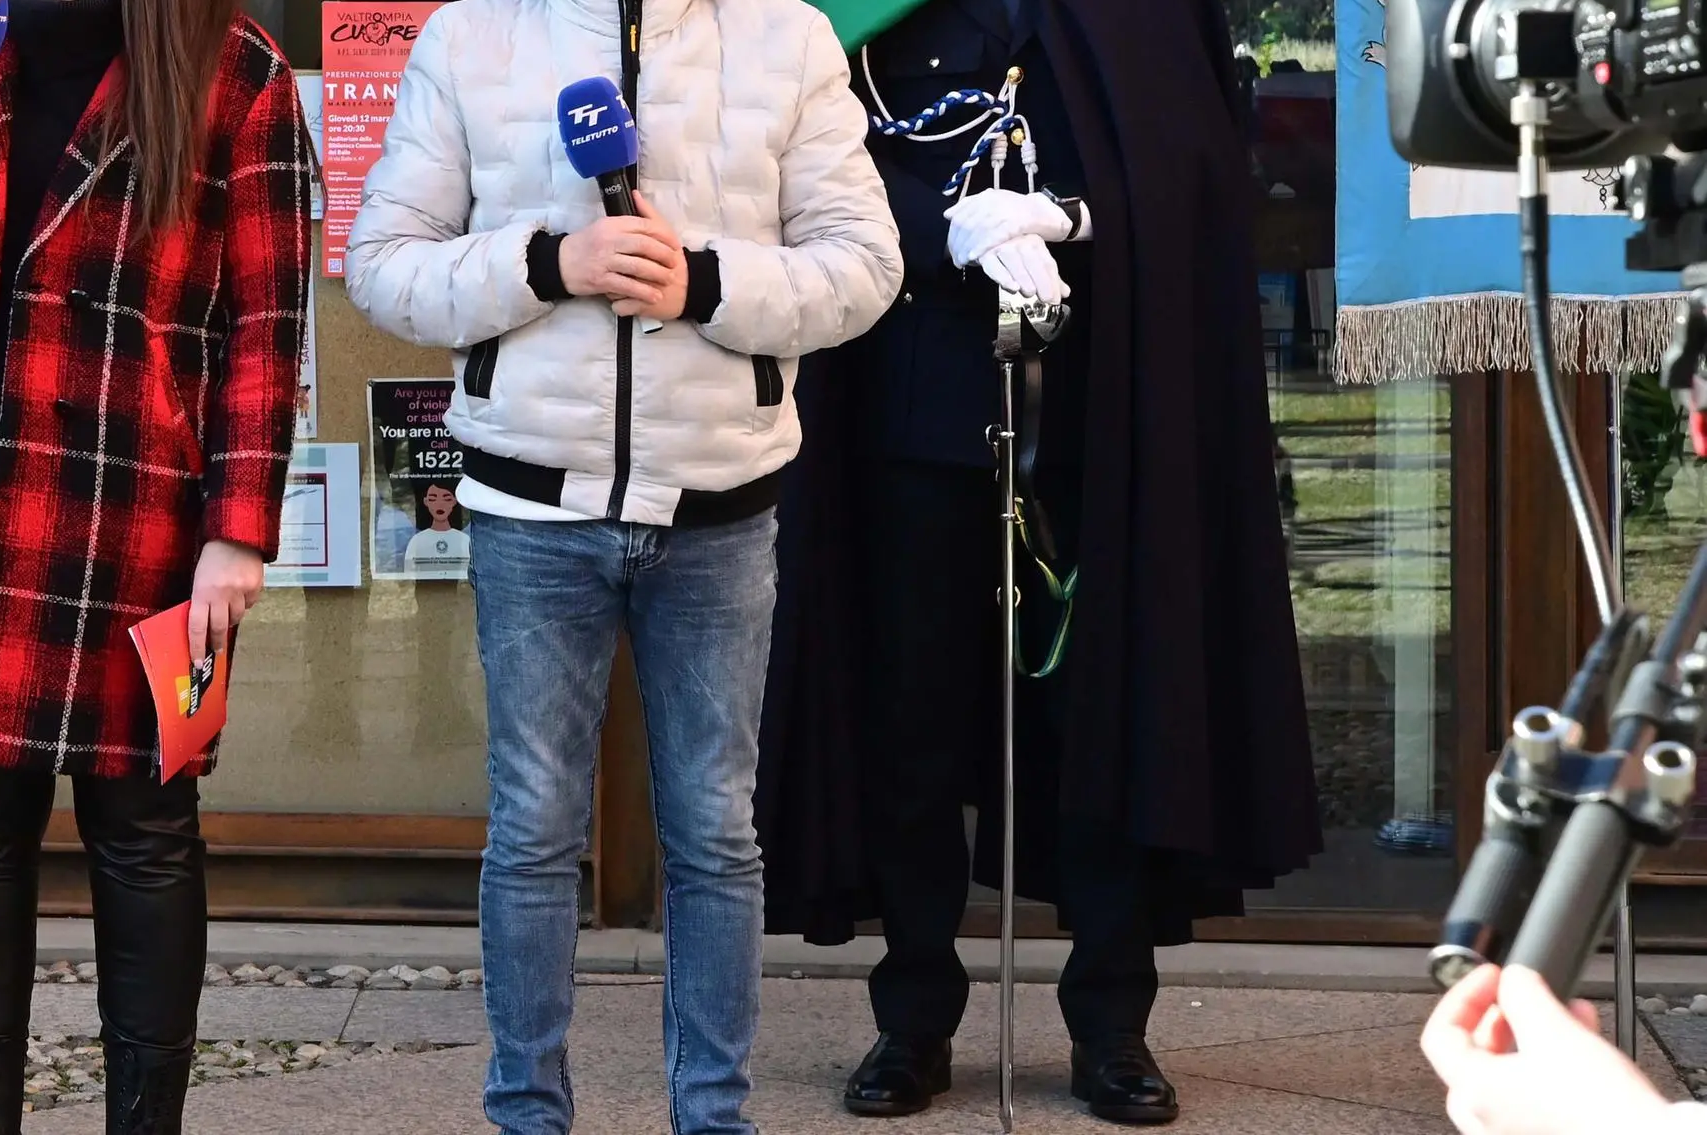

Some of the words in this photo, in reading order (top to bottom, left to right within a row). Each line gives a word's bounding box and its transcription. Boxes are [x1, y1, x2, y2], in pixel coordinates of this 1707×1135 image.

[337, 12, 413, 23] VALTROMPIA
[325, 71, 390, 79] PRESENTAZIONE
[325, 83, 398, 100] TRAN
[359, 114, 370, 122] 12
[342, 124, 366, 133] 20:30
[571, 125, 619, 147] TELETUTTO
[394, 388, 414, 398] Are
[416, 389, 437, 399] you
[440, 390, 447, 398] a
[408, 401, 420, 410] of
[406, 414, 418, 422] or
[421, 413, 444, 422] stal
[379, 426, 406, 438] You
[409, 428, 431, 437] are
[430, 440, 449, 449] Call
[415, 451, 464, 468] 1522
